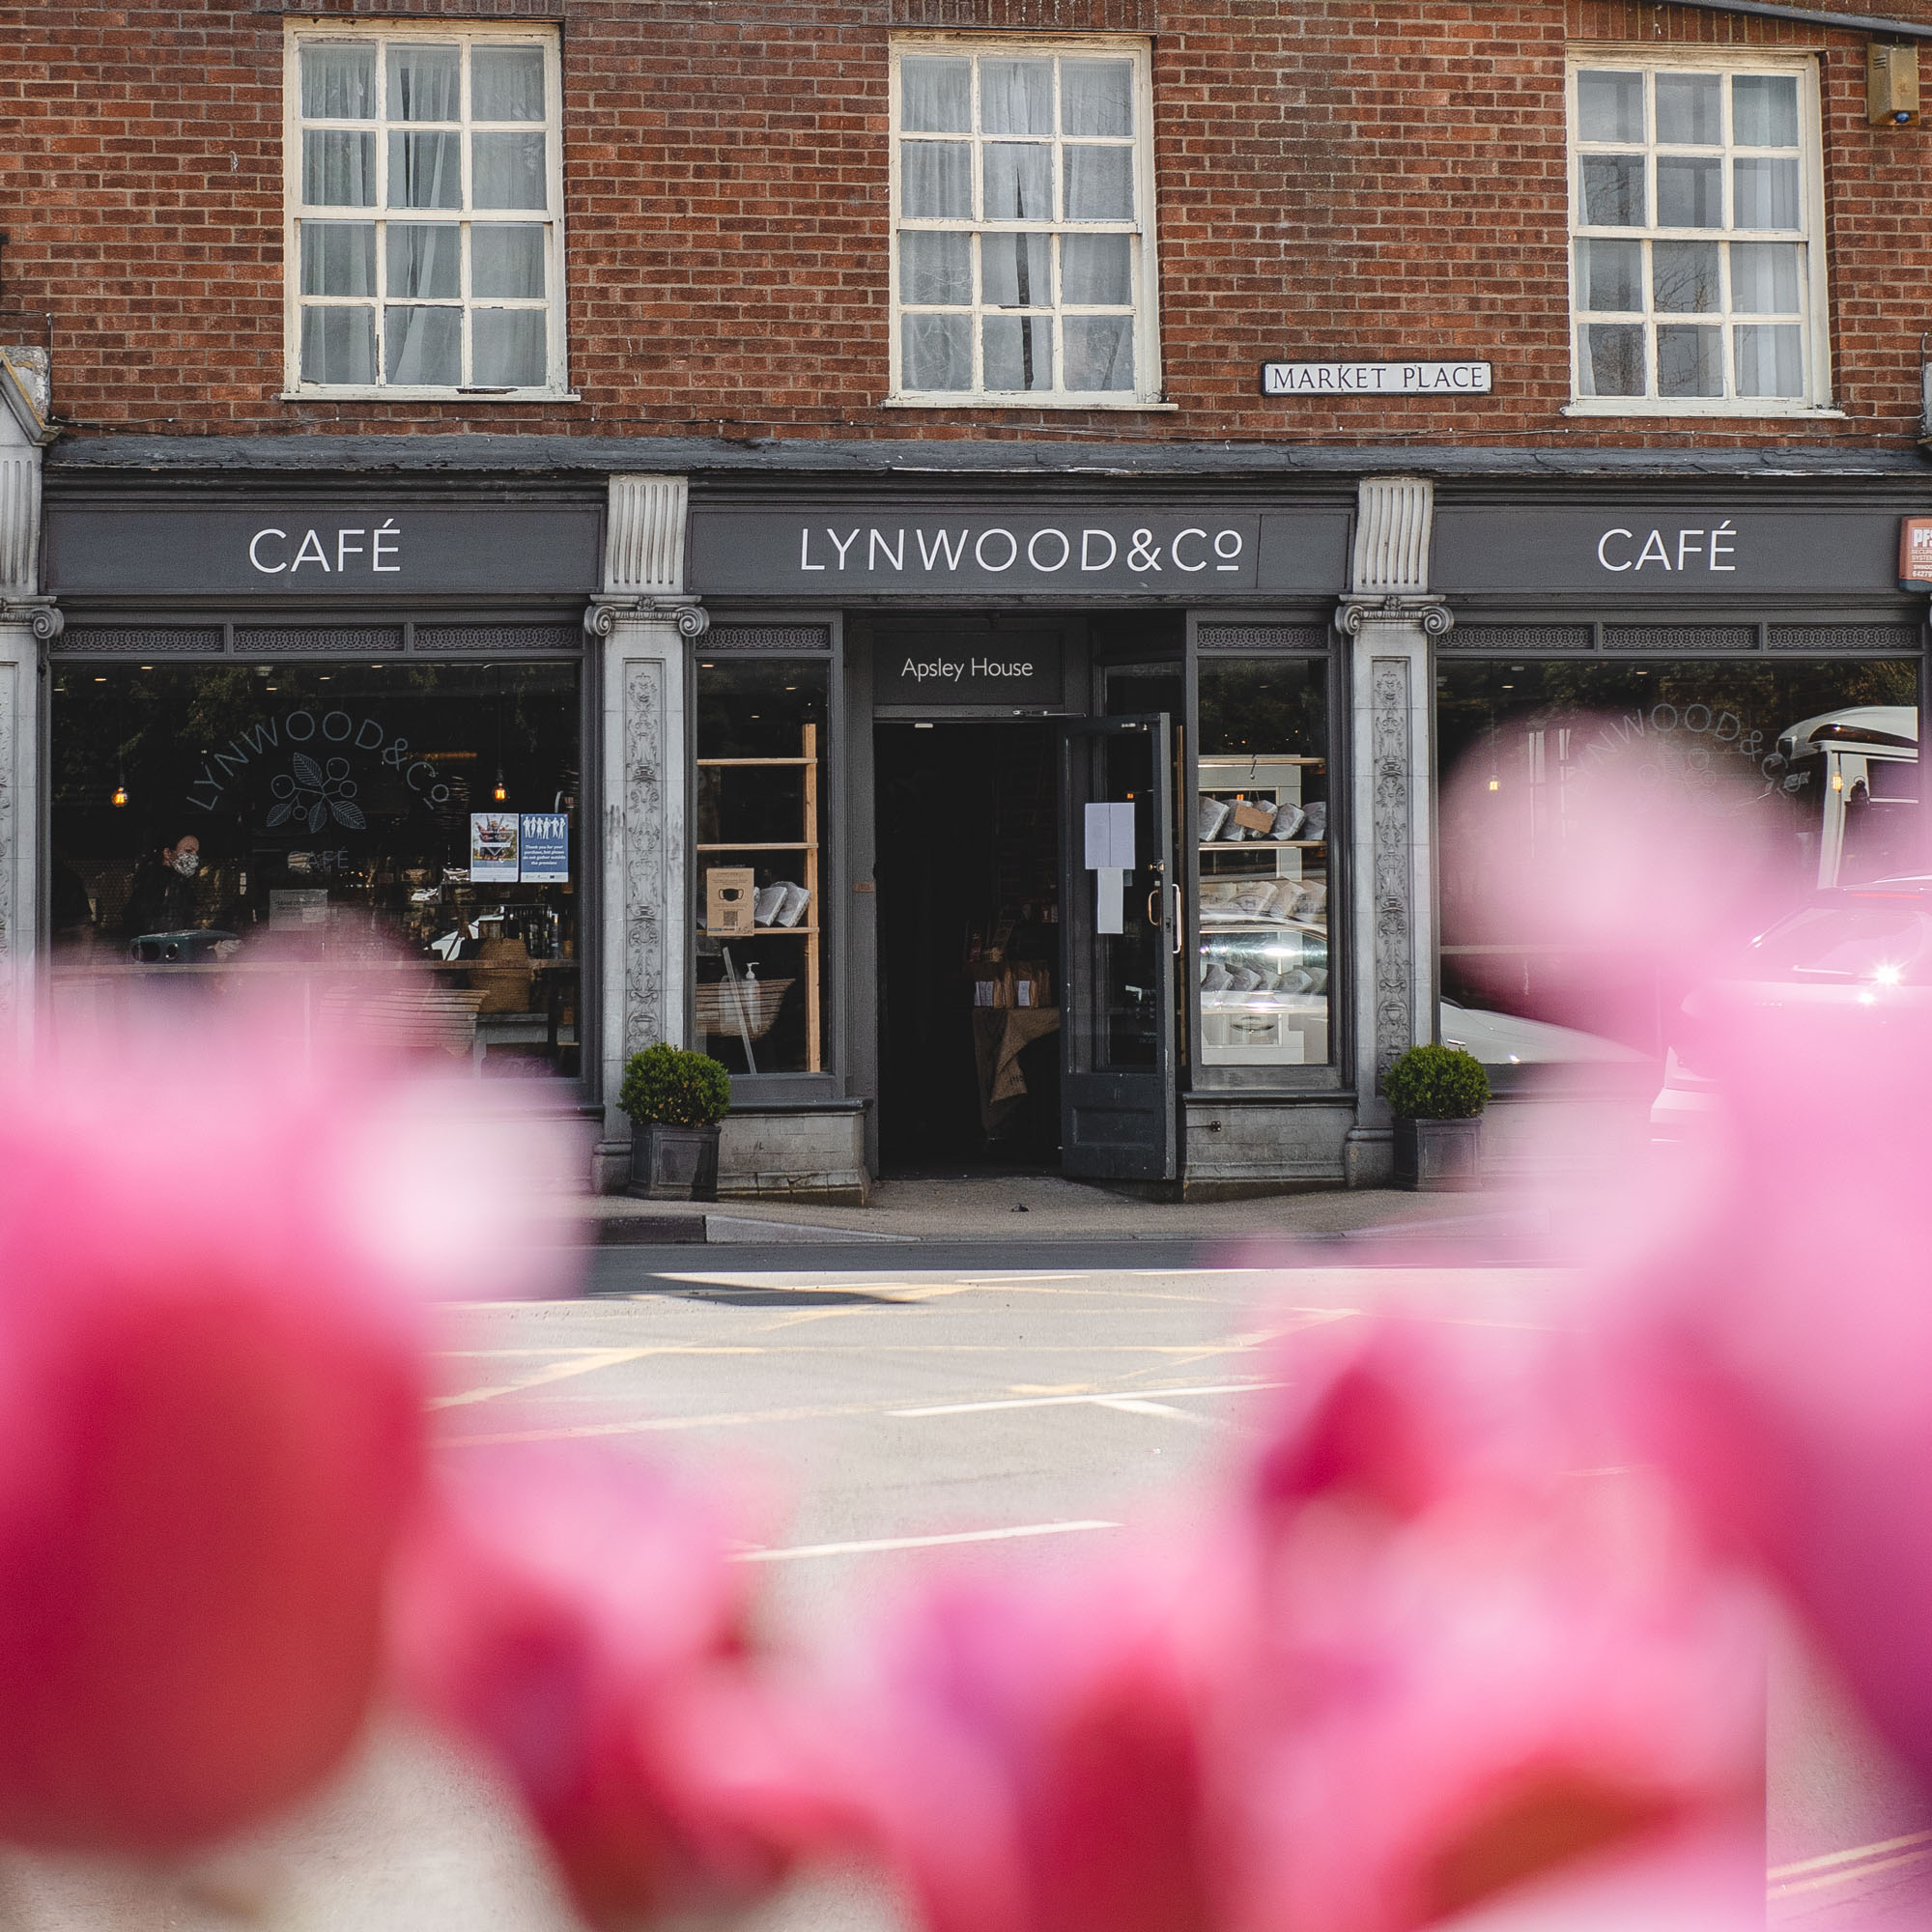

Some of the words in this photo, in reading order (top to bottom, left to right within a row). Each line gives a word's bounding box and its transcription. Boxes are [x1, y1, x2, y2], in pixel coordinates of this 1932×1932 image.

[1273, 368, 1387, 388] MARKET
[1403, 366, 1484, 387] PLACE
[249, 518, 401, 573] CAFÉ
[1598, 520, 1737, 571] CAFÉ
[901, 658, 965, 682] Apsley
[971, 658, 1034, 676] House
